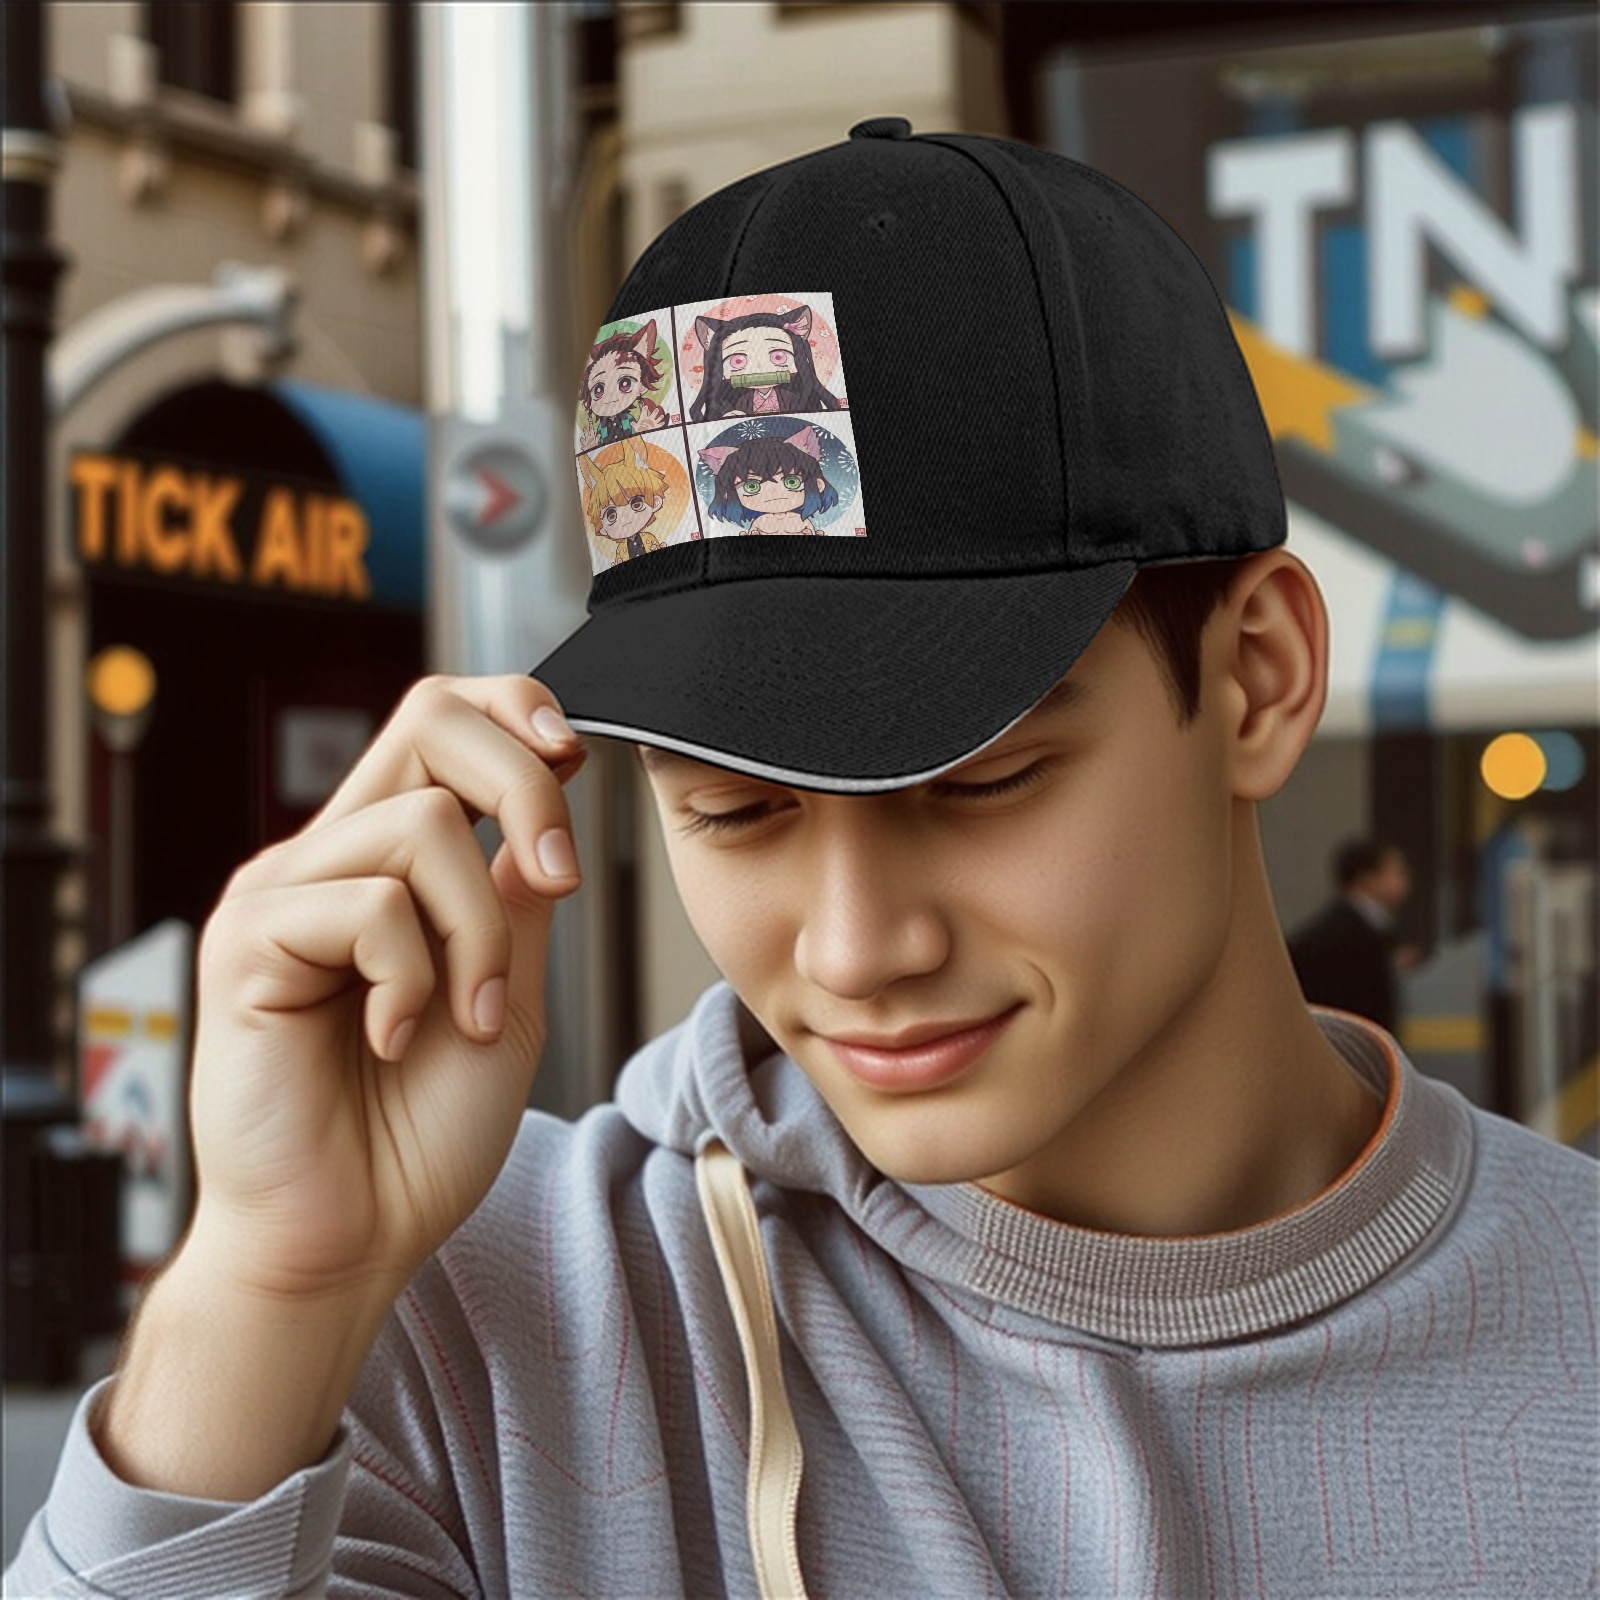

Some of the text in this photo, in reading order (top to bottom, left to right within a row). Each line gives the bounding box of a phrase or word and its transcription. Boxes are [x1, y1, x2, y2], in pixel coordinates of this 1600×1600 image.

[1208, 105, 1575, 356] TN
[70, 454, 369, 599] TICK AIR
